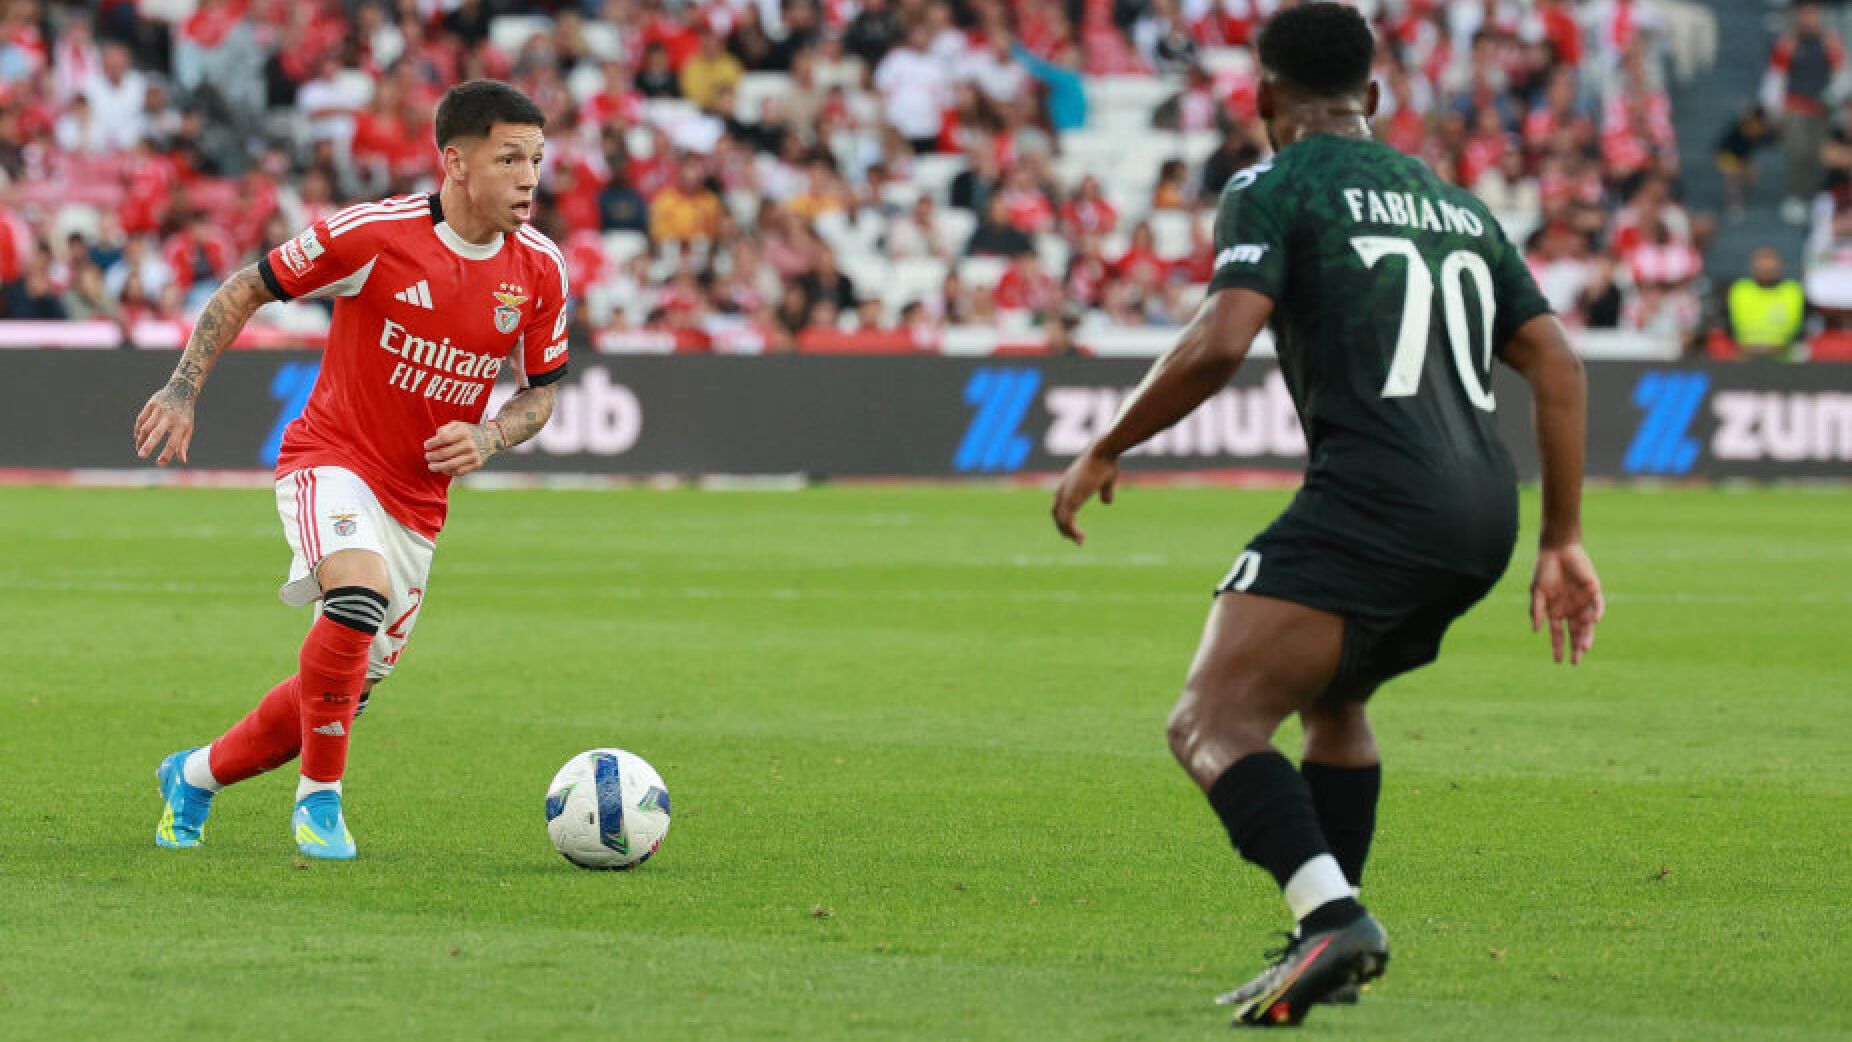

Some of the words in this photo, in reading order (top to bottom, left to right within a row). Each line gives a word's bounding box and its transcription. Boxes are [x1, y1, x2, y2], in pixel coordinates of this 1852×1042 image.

[1343, 187, 1484, 237] FABIANO
[380, 318, 507, 379] Emirate
[1349, 236, 1496, 413] 70
[389, 362, 427, 393] FLY
[424, 374, 485, 406] BETTER
